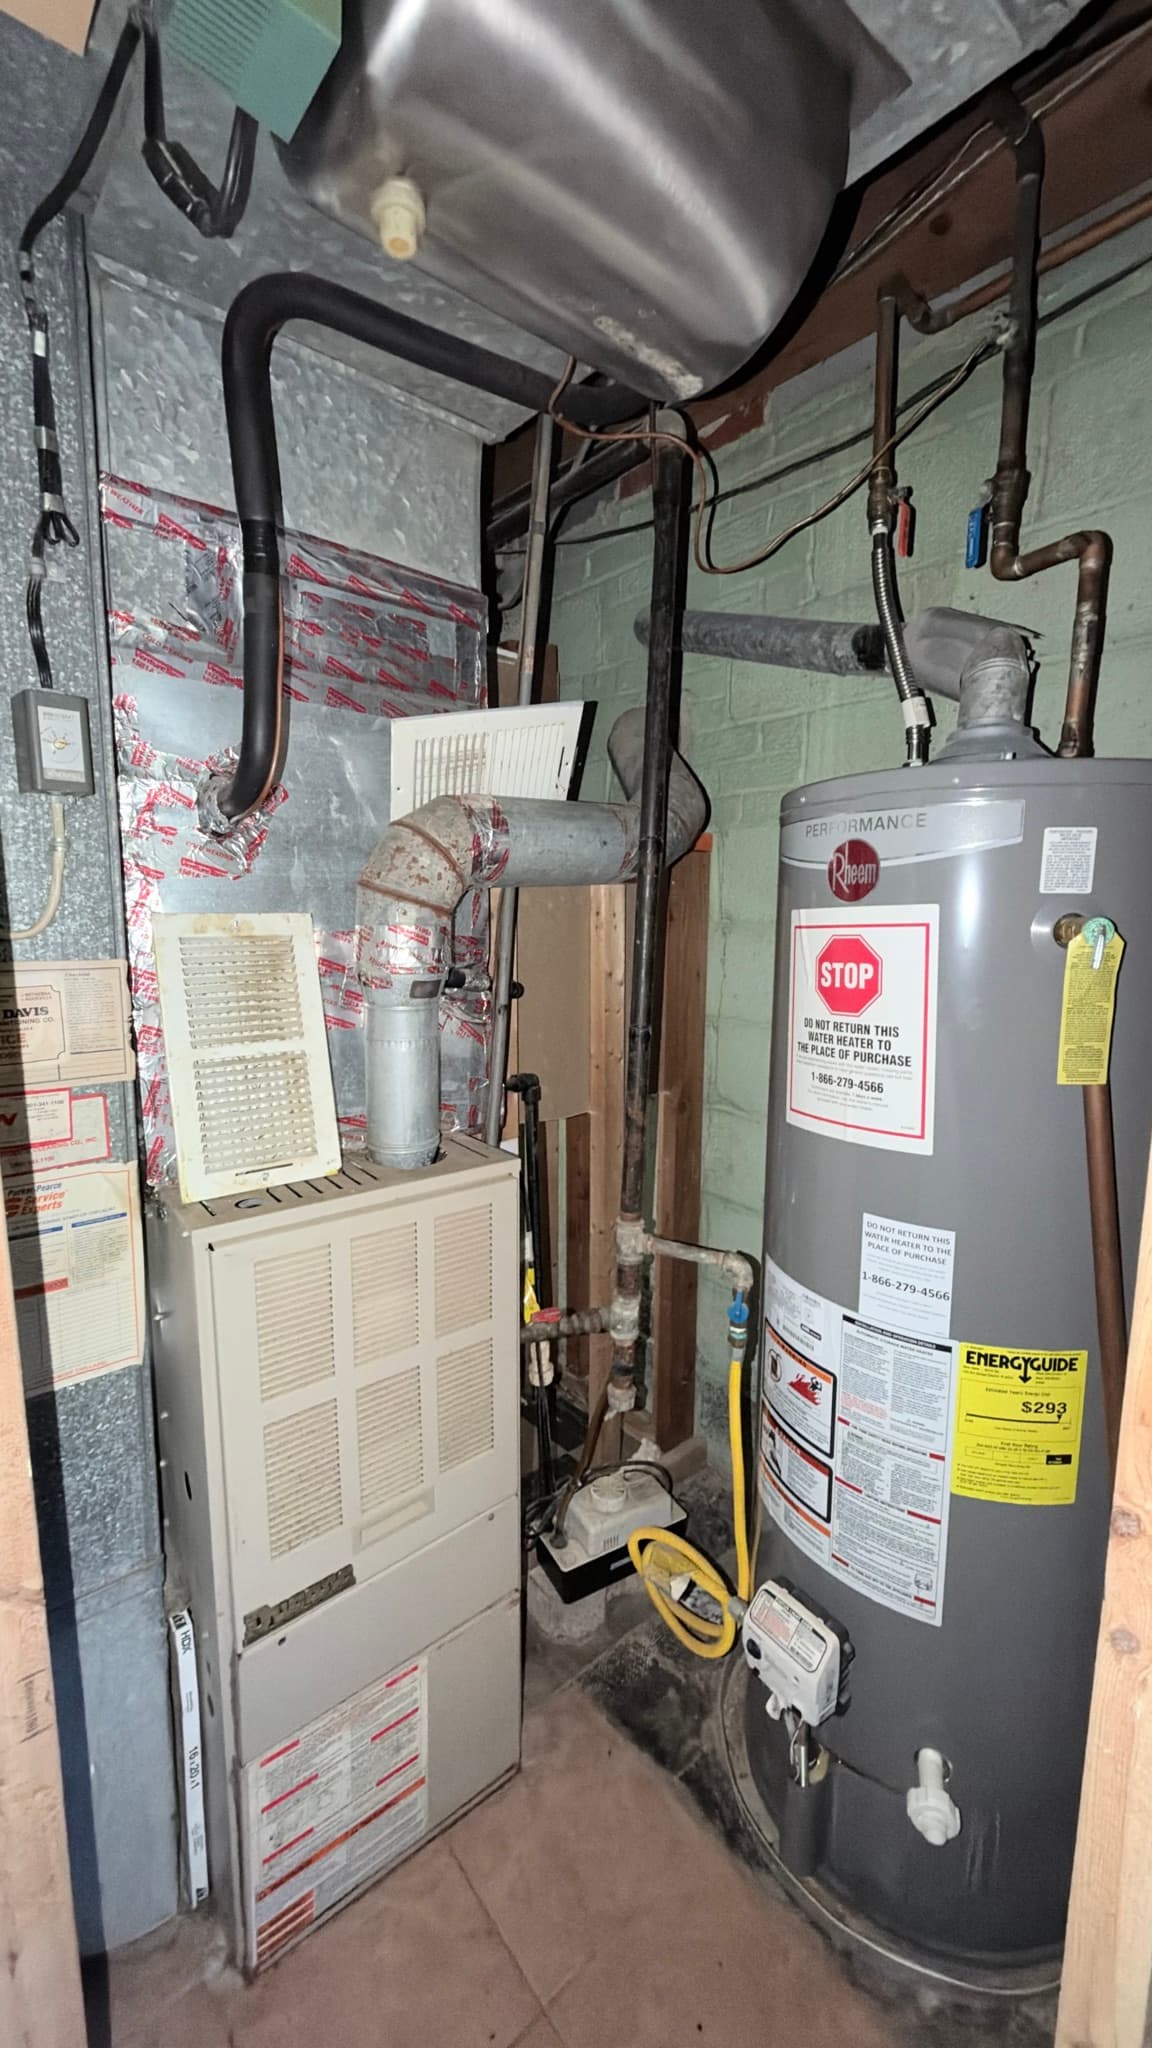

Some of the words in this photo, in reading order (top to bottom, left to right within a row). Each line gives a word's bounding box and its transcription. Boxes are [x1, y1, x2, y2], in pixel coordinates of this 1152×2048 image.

[805, 812, 928, 838] PERFORMANCE
[832, 841, 876, 893] Rheem
[820, 962, 875, 990] STOP
[3, 1006, 49, 1019] DAVIS
[804, 1017, 814, 1029] DO
[815, 1019, 831, 1031] NOT
[833, 1021, 871, 1036] RETURN
[875, 1025, 899, 1038] THIS
[808, 1031, 834, 1045] WATER
[836, 1035, 874, 1050] HEATER
[878, 1039, 892, 1052] TO
[797, 1041, 809, 1054] THE
[810, 1044, 836, 1059] PLACE
[838, 1047, 851, 1061] OF
[853, 1051, 912, 1068] PURCHASE
[810, 1072, 884, 1094] 1-866-279-4566
[23, 1191, 66, 1205] Service
[864, 1231, 890, 1245] WATER
[891, 1237, 922, 1251] HEATER
[923, 1243, 934, 1253] TO
[936, 1246, 952, 1256] THE
[866, 1220, 878, 1230] DO
[879, 1222, 897, 1234] NOT
[898, 1228, 930, 1242] RETURN
[932, 1235, 951, 1246] THIS
[867, 1241, 890, 1253] PLACE
[891, 1247, 901, 1256] OF
[904, 1251, 946, 1266] PURCHASE
[862, 1271, 951, 1302] 1-866-279-4566
[966, 1351, 1079, 1374] ENERGYGUIDE
[1021, 1401, 1067, 1415] $293
[180, 1630, 192, 1655] HDX
